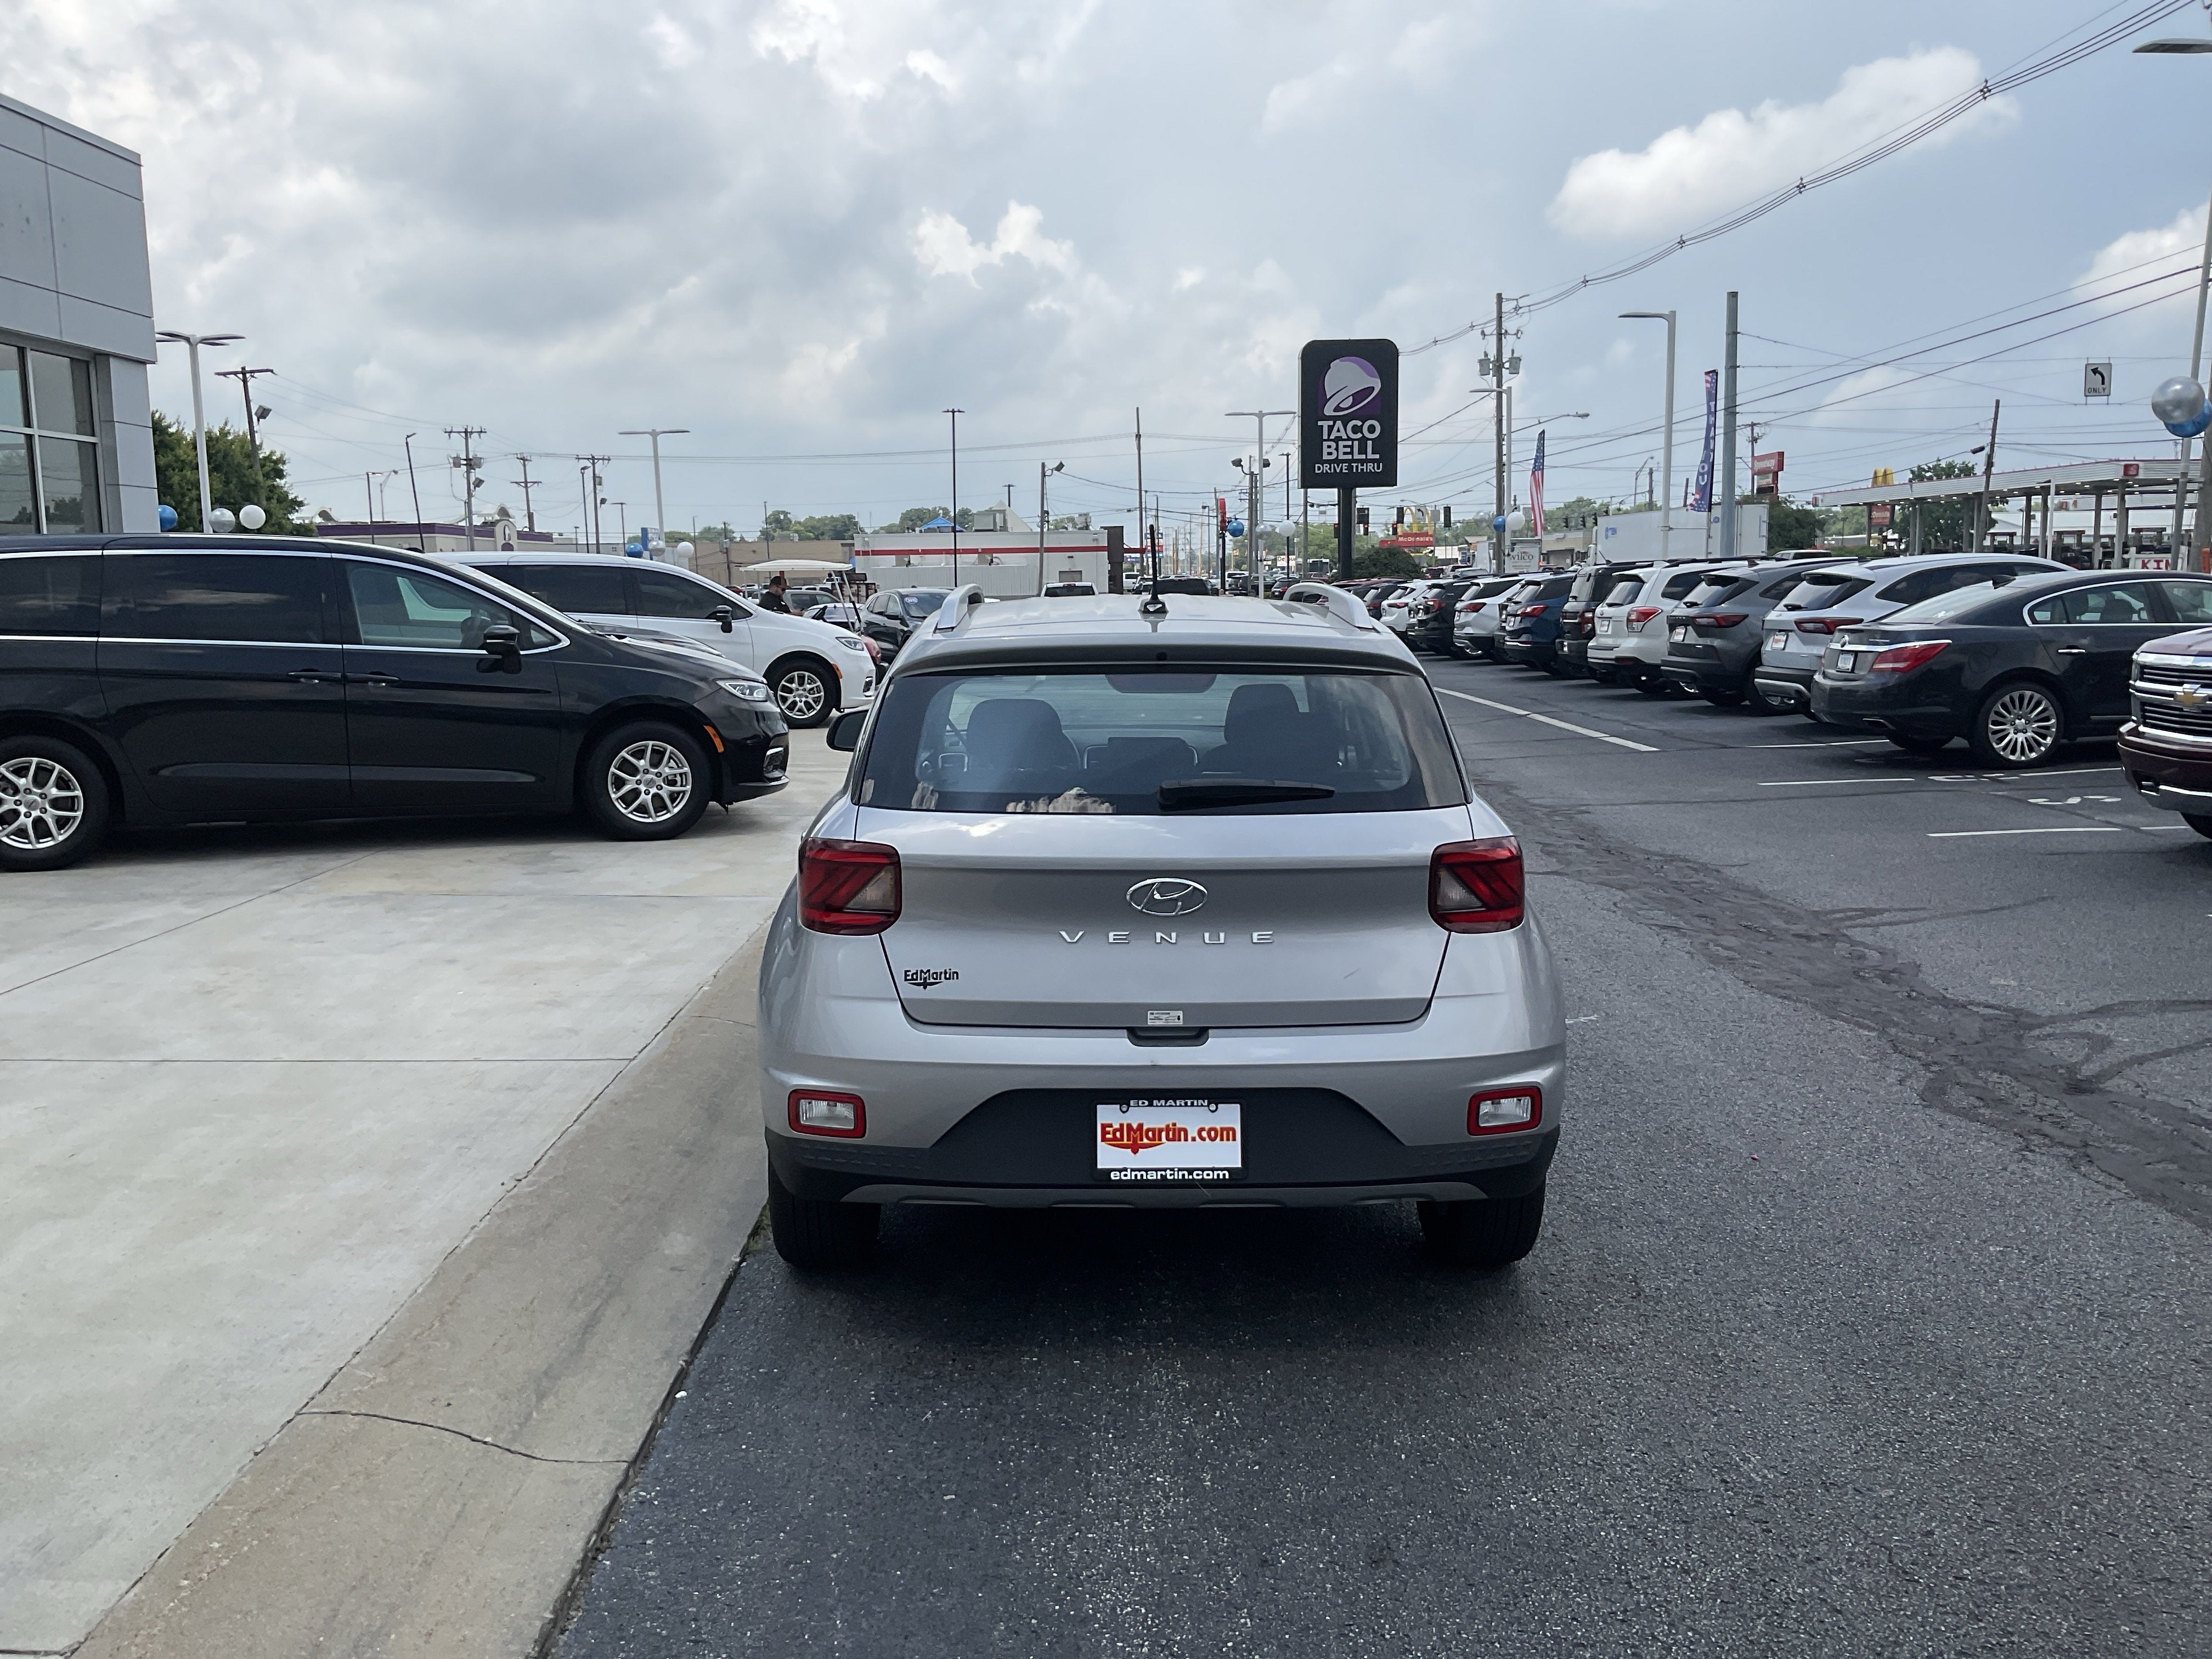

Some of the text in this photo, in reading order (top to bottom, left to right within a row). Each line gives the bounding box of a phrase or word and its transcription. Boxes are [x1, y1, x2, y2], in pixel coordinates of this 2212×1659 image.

[1318, 420, 1381, 439] TACO
[1322, 441, 1380, 460] BELL
[1314, 462, 1383, 473] DRIVE THRU
[1059, 930, 1274, 944] VENUE
[904, 968, 960, 982] EdMartin
[1101, 1122, 1237, 1143] EdMartin.com
[1110, 1168, 1229, 1180] edmartin.com
